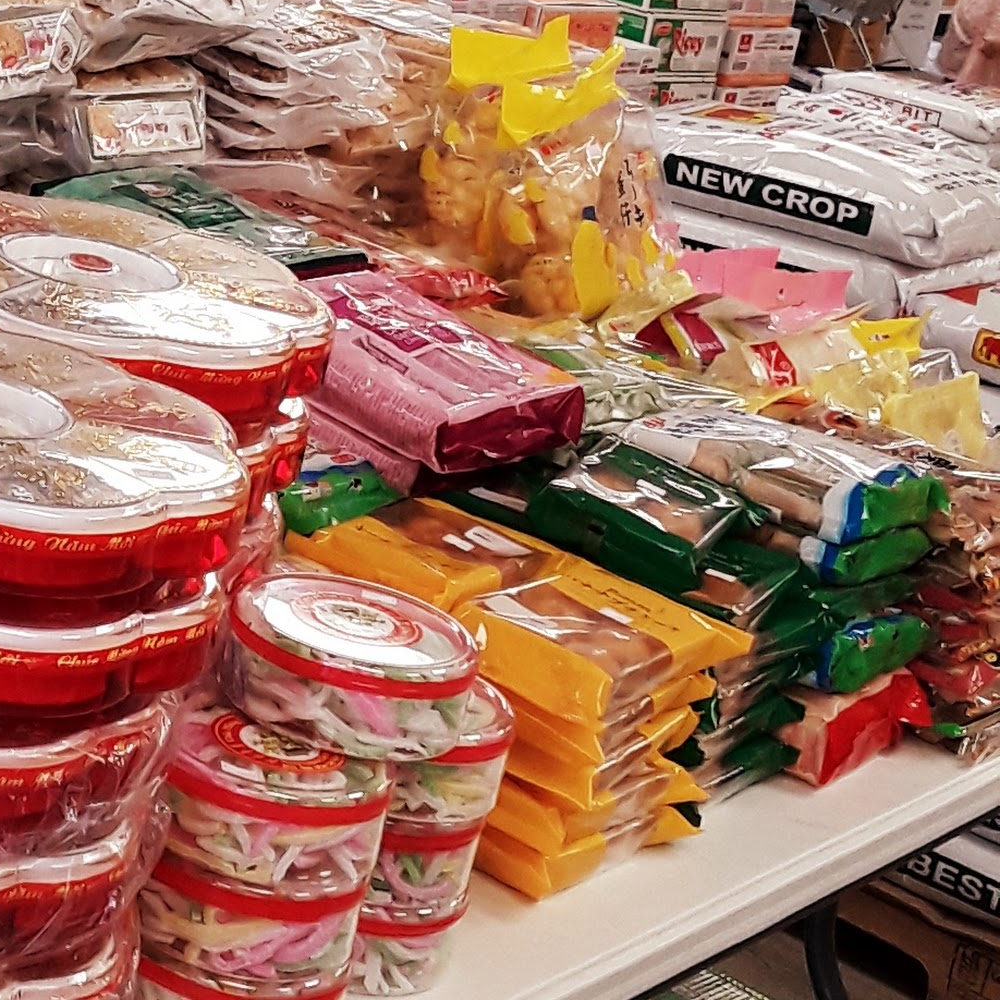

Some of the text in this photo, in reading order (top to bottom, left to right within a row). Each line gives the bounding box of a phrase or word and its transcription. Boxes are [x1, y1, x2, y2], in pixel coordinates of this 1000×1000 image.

[676, 161, 753, 198] NEW
[761, 182, 859, 224] CROP
[907, 853, 1000, 911] BEST
